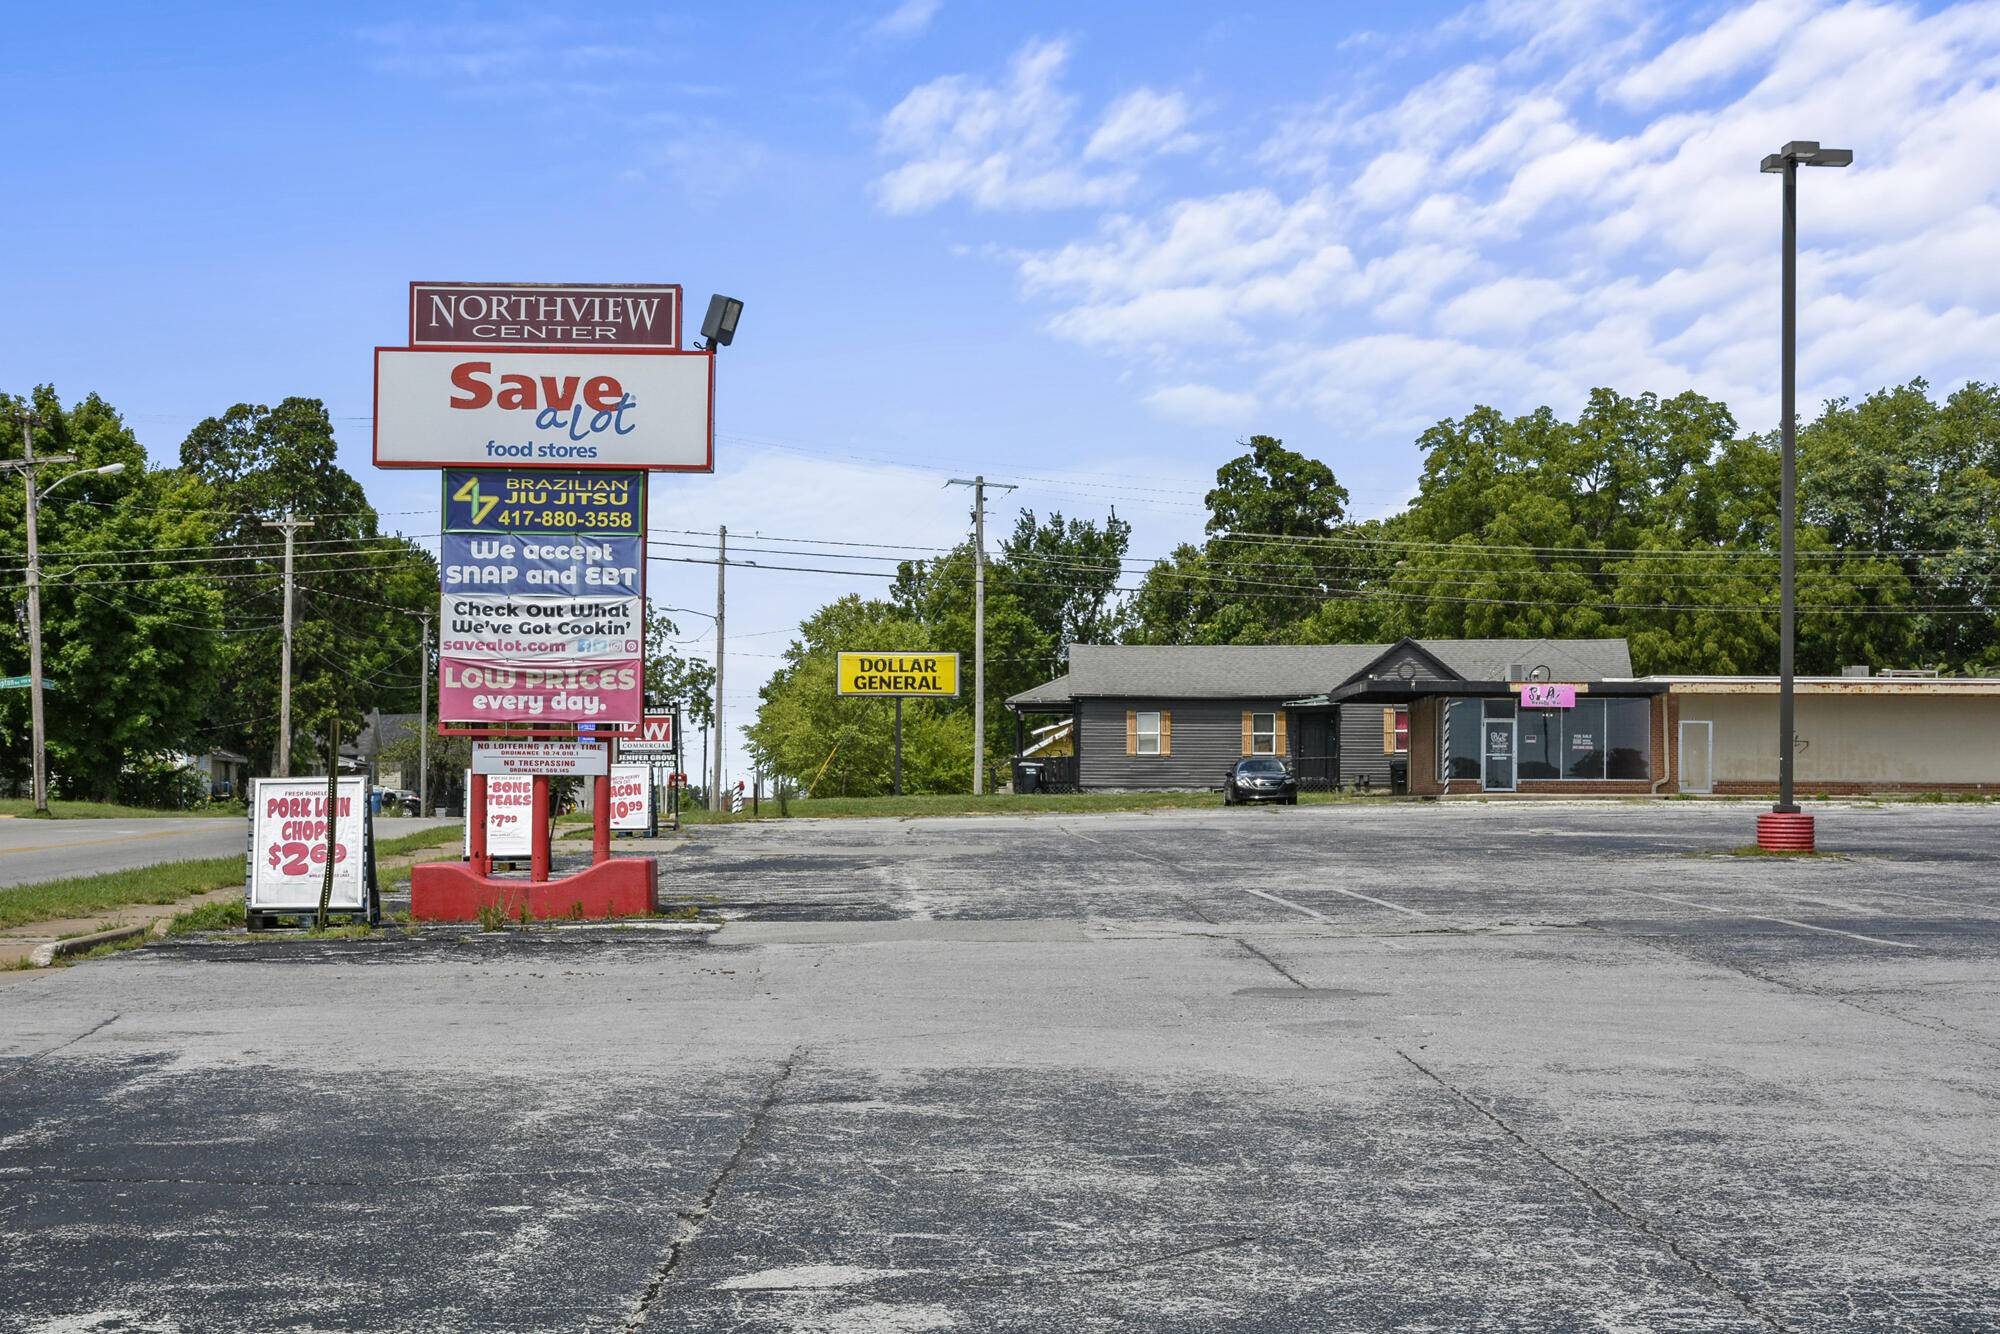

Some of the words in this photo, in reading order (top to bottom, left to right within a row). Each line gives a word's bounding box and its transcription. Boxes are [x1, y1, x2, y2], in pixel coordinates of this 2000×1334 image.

[429, 295, 661, 331] NORTHVIEW
[472, 325, 616, 339] CENTER
[450, 361, 623, 411] Save
[486, 440, 533, 457] food
[538, 442, 597, 458] stores
[506, 478, 628, 491] BRAZILIAN
[504, 491, 547, 504] JIU
[553, 492, 628, 505] JITSU
[498, 510, 632, 527] 417-880-3558
[470, 541, 516, 559] We
[523, 543, 613, 564] accept
[446, 565, 518, 584] SNAP
[526, 566, 577, 585] and
[584, 567, 638, 586] EBT
[454, 601, 520, 618] Check
[526, 604, 564, 618] Out
[570, 603, 629, 618] What
[452, 620, 512, 634] We've
[519, 621, 552, 635] Got
[558, 621, 631, 635] Cookin'
[443, 639, 566, 652] savealot.com
[859, 658, 937, 672] DOLLAR
[445, 667, 516, 689] LOW
[526, 669, 636, 690] PRICES
[854, 676, 942, 690] GENERAL
[472, 692, 544, 714] every
[550, 691, 607, 715] day.
[488, 781, 531, 793] -BONE
[610, 783, 642, 798] ACON
[267, 797, 312, 818] PORK
[487, 794, 532, 806] TEAKS
[610, 801, 643, 820] 1099
